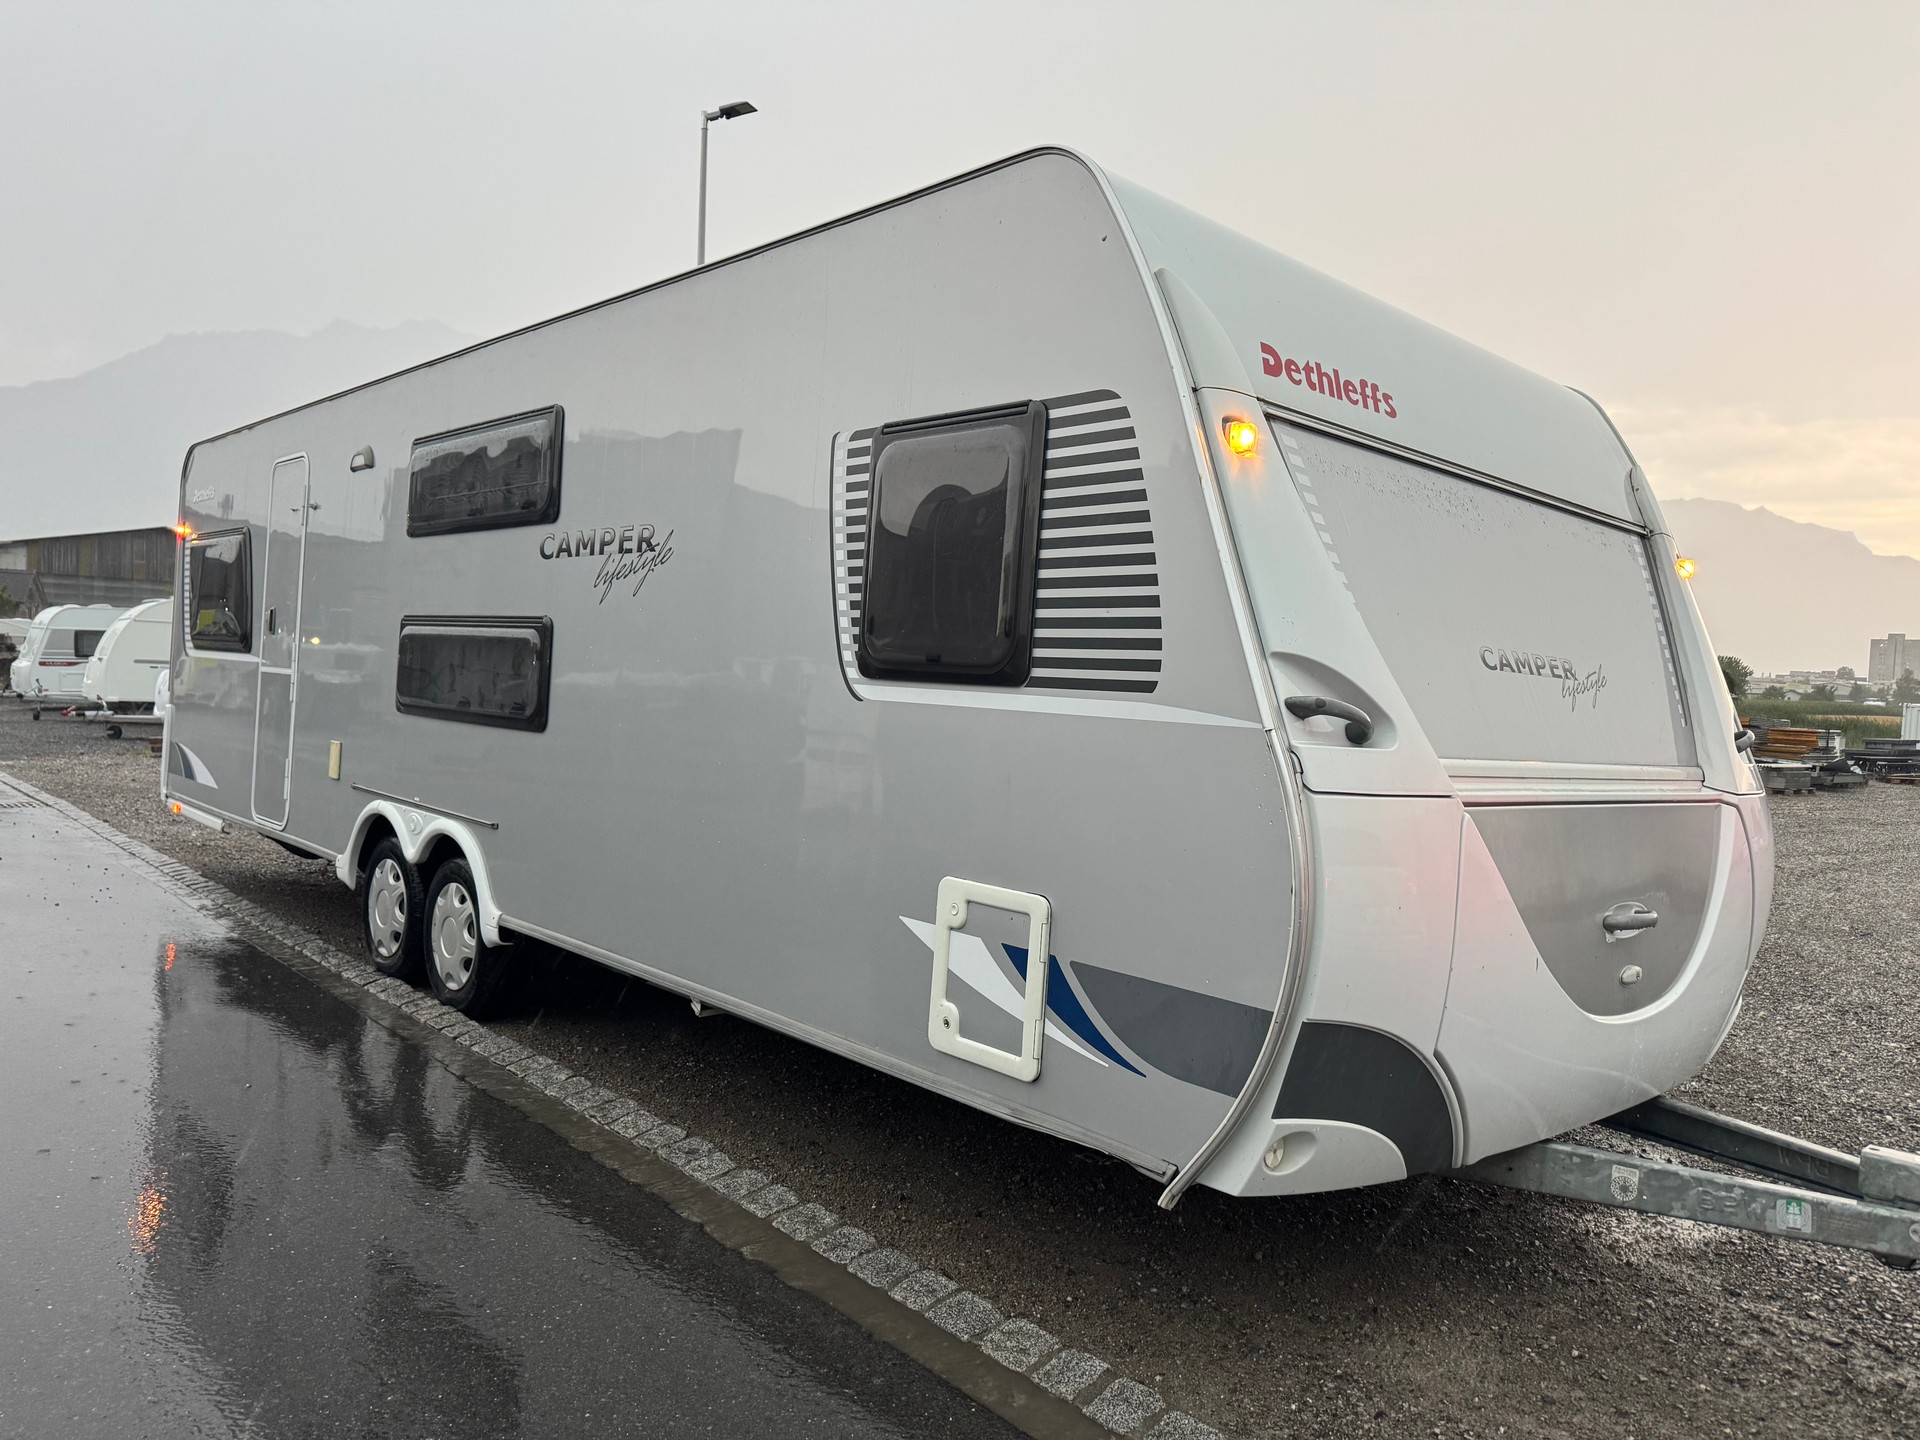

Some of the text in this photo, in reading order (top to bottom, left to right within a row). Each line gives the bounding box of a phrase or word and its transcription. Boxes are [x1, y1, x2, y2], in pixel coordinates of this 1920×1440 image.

[1260, 341, 1397, 419] Dethleffs
[539, 523, 657, 560] CAMPER
[593, 529, 675, 606] lifestyle
[1479, 645, 1579, 681] CAMPER
[1561, 663, 1607, 713] lifestyle
